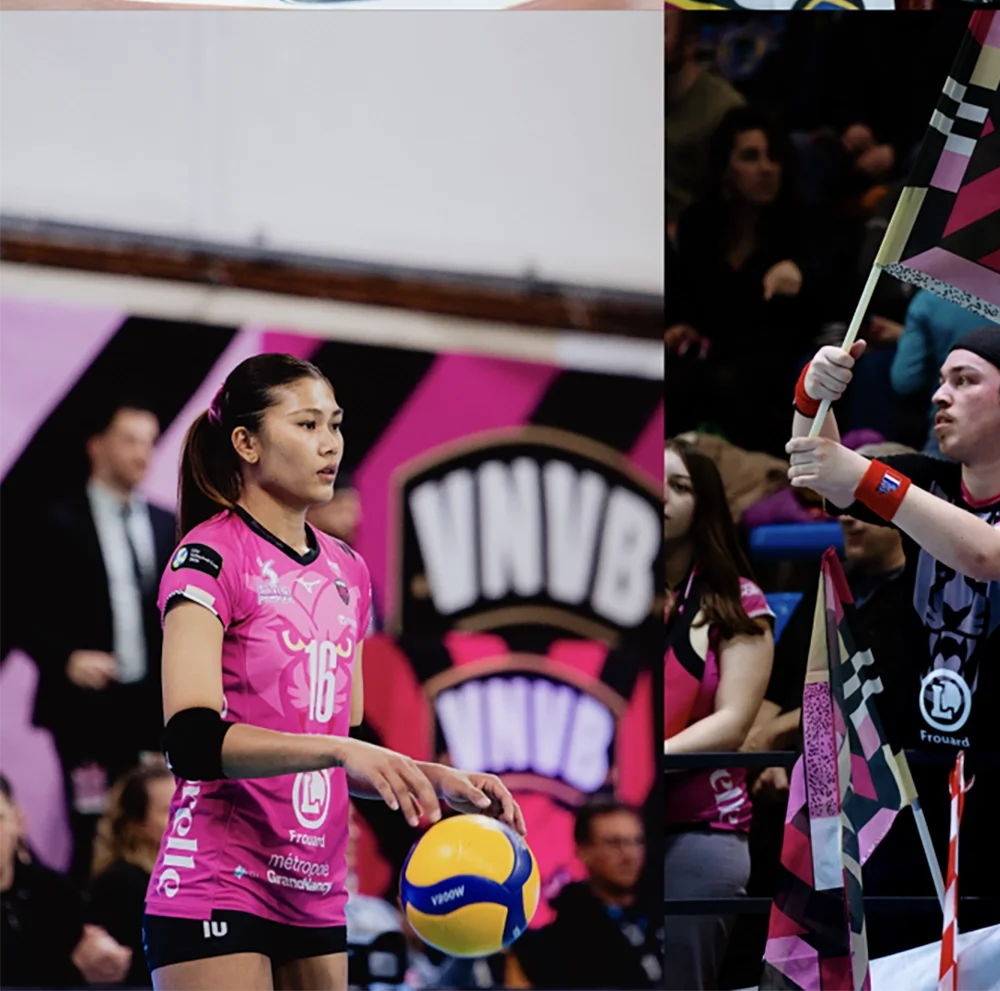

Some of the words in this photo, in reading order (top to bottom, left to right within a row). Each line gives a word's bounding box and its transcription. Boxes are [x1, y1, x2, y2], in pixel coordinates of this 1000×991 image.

[408, 456, 661, 626] VNVB
[305, 639, 337, 723] 16
[920, 729, 970, 748] Frouard
[156, 779, 200, 898] relle
